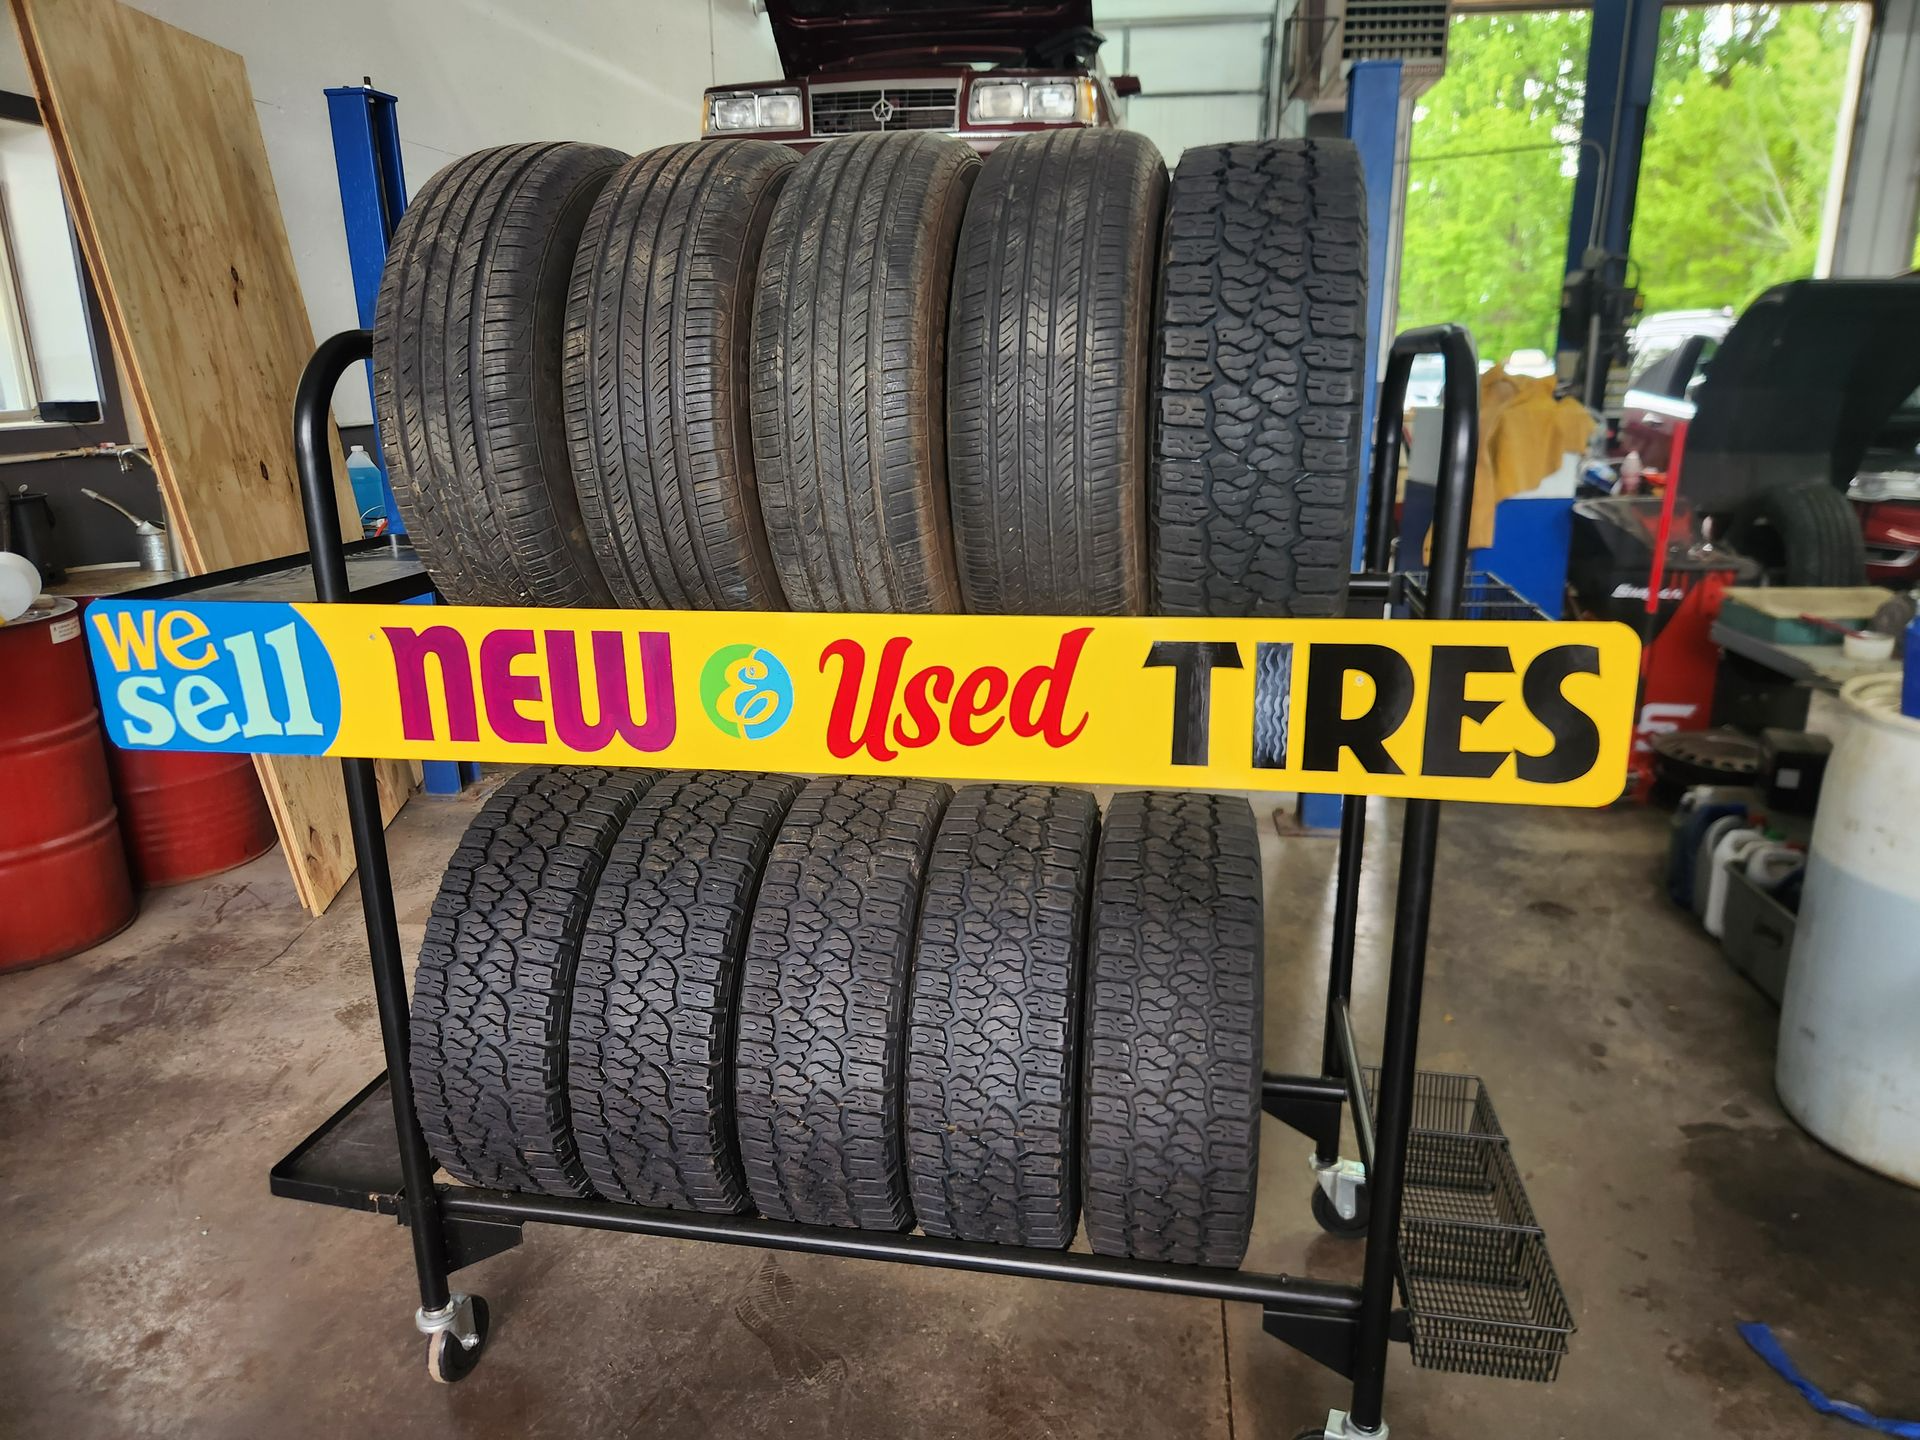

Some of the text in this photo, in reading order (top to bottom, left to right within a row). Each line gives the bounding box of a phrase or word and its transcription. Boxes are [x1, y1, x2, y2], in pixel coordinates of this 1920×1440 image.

[117, 622, 324, 746] sell
[716, 647, 779, 740] &
[818, 627, 1095, 762] Used
[1142, 641, 1602, 784] TIRES
